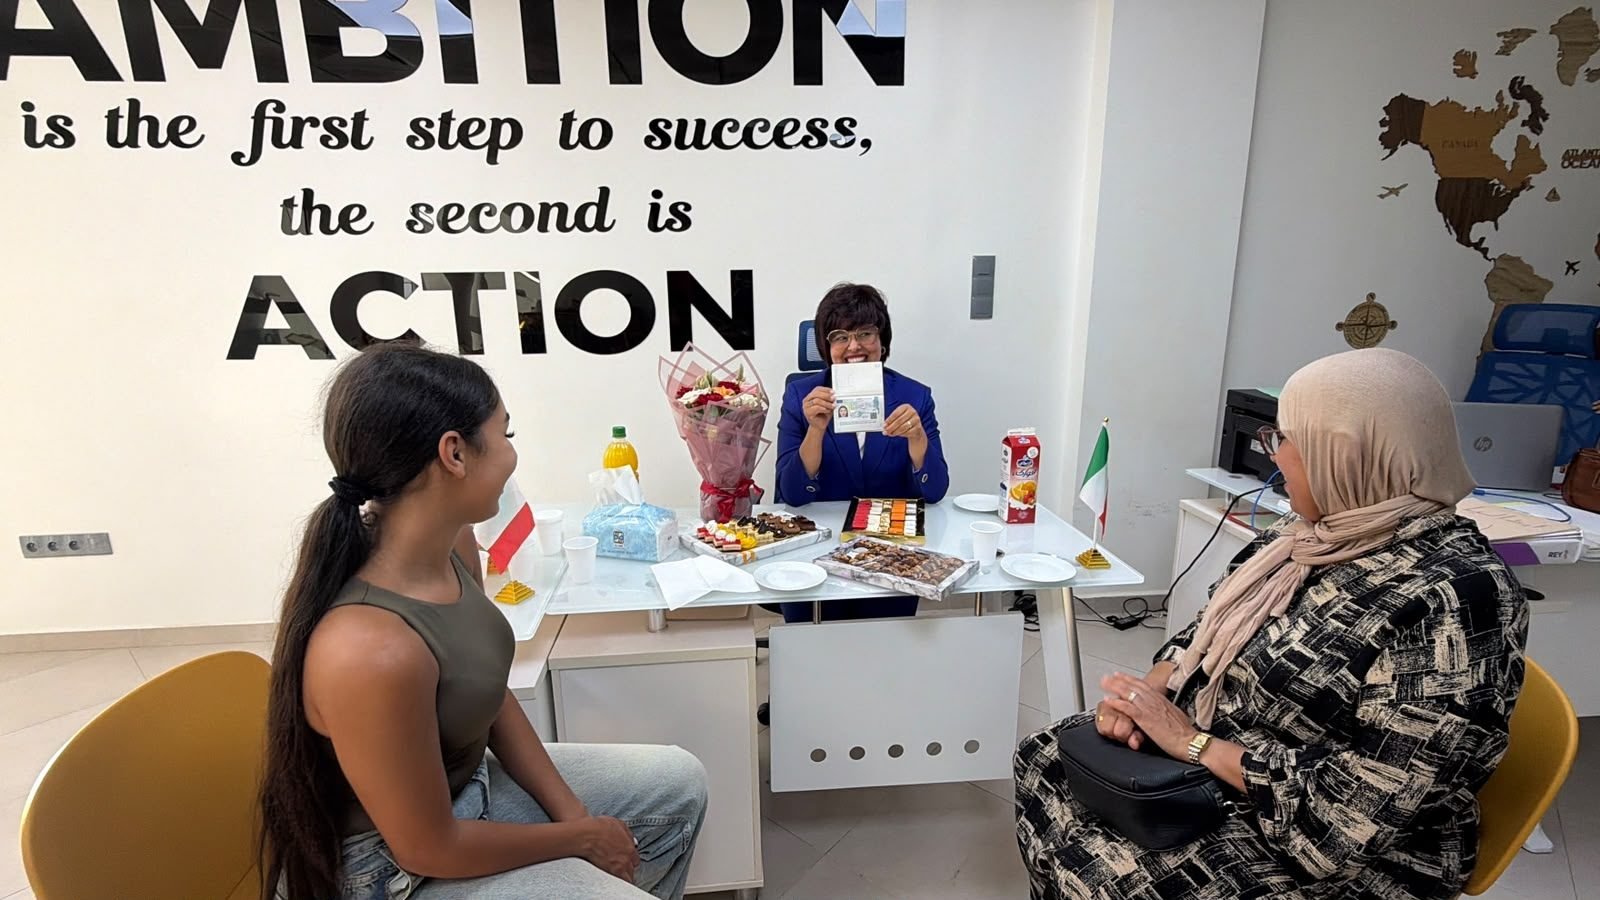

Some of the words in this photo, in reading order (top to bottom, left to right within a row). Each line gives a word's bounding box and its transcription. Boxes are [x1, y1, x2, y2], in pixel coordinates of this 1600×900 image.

[20, 101, 76, 149] is
[104, 98, 205, 149] the
[230, 98, 375, 167] first
[405, 108, 524, 165] step
[558, 109, 614, 151] to
[643, 116, 873, 157] success,
[280, 188, 375, 236] the
[405, 186, 617, 235] second
[647, 189, 693, 233] is
[226, 269, 755, 360] ACTION
